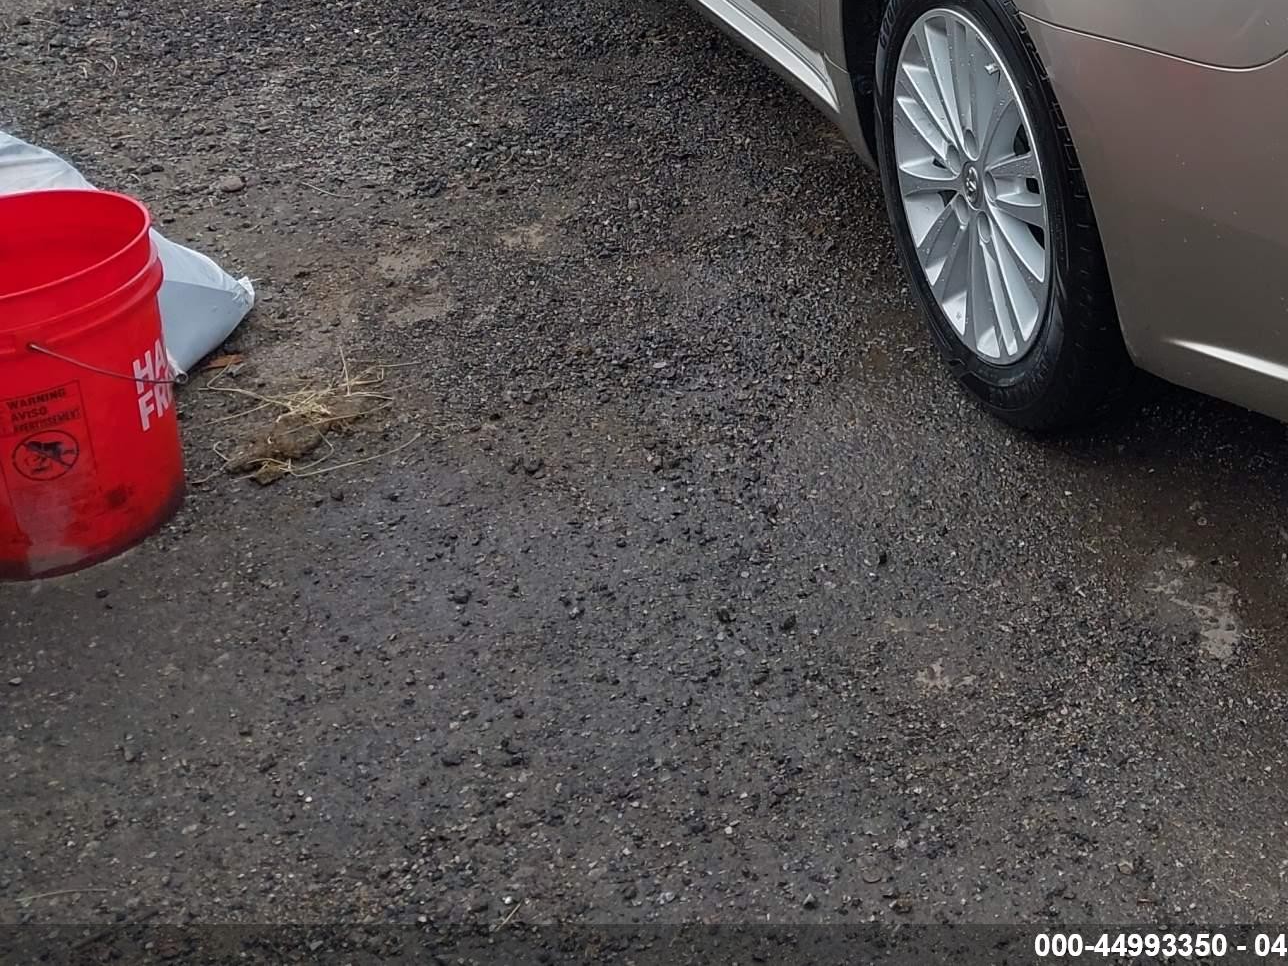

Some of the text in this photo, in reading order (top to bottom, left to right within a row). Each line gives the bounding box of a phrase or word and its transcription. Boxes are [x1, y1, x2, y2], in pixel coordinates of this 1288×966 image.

[132, 338, 172, 395] HA
[6, 388, 66, 410] WARNING
[11, 406, 48, 422] AVISO
